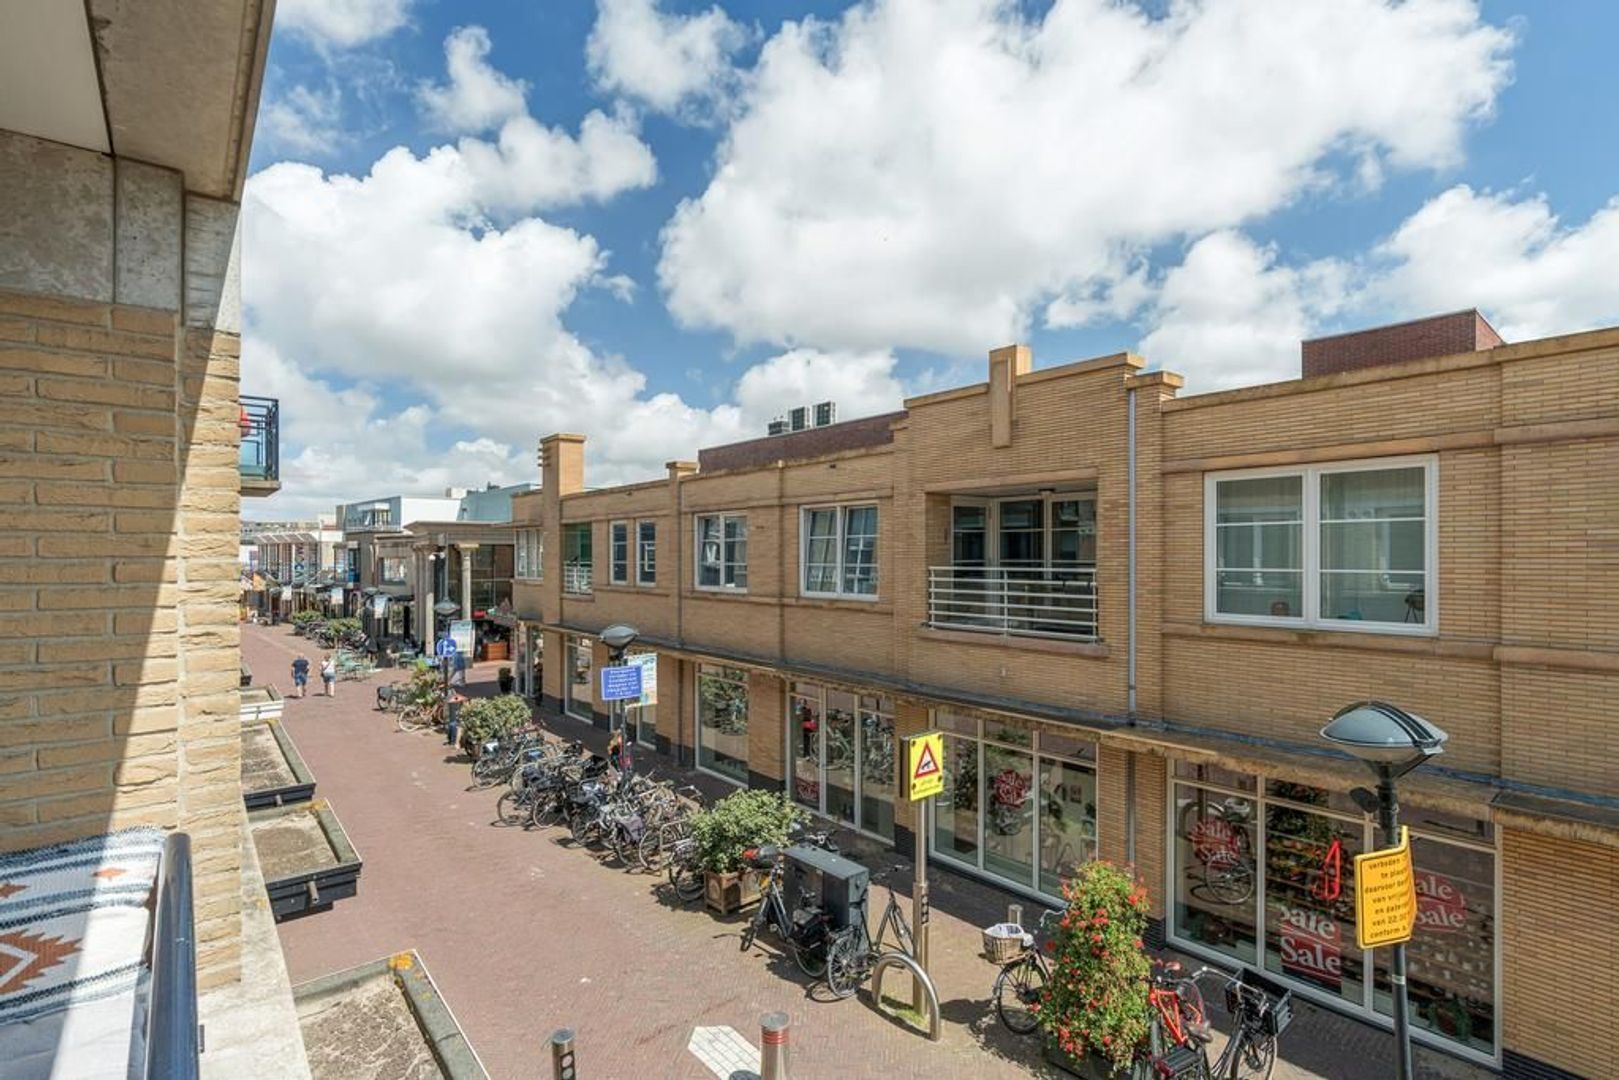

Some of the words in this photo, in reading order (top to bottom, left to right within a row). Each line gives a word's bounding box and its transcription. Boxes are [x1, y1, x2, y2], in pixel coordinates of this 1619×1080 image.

[1414, 874, 1453, 900] ale
[1370, 927, 1401, 940] conform
[1280, 935, 1342, 975] Sale
